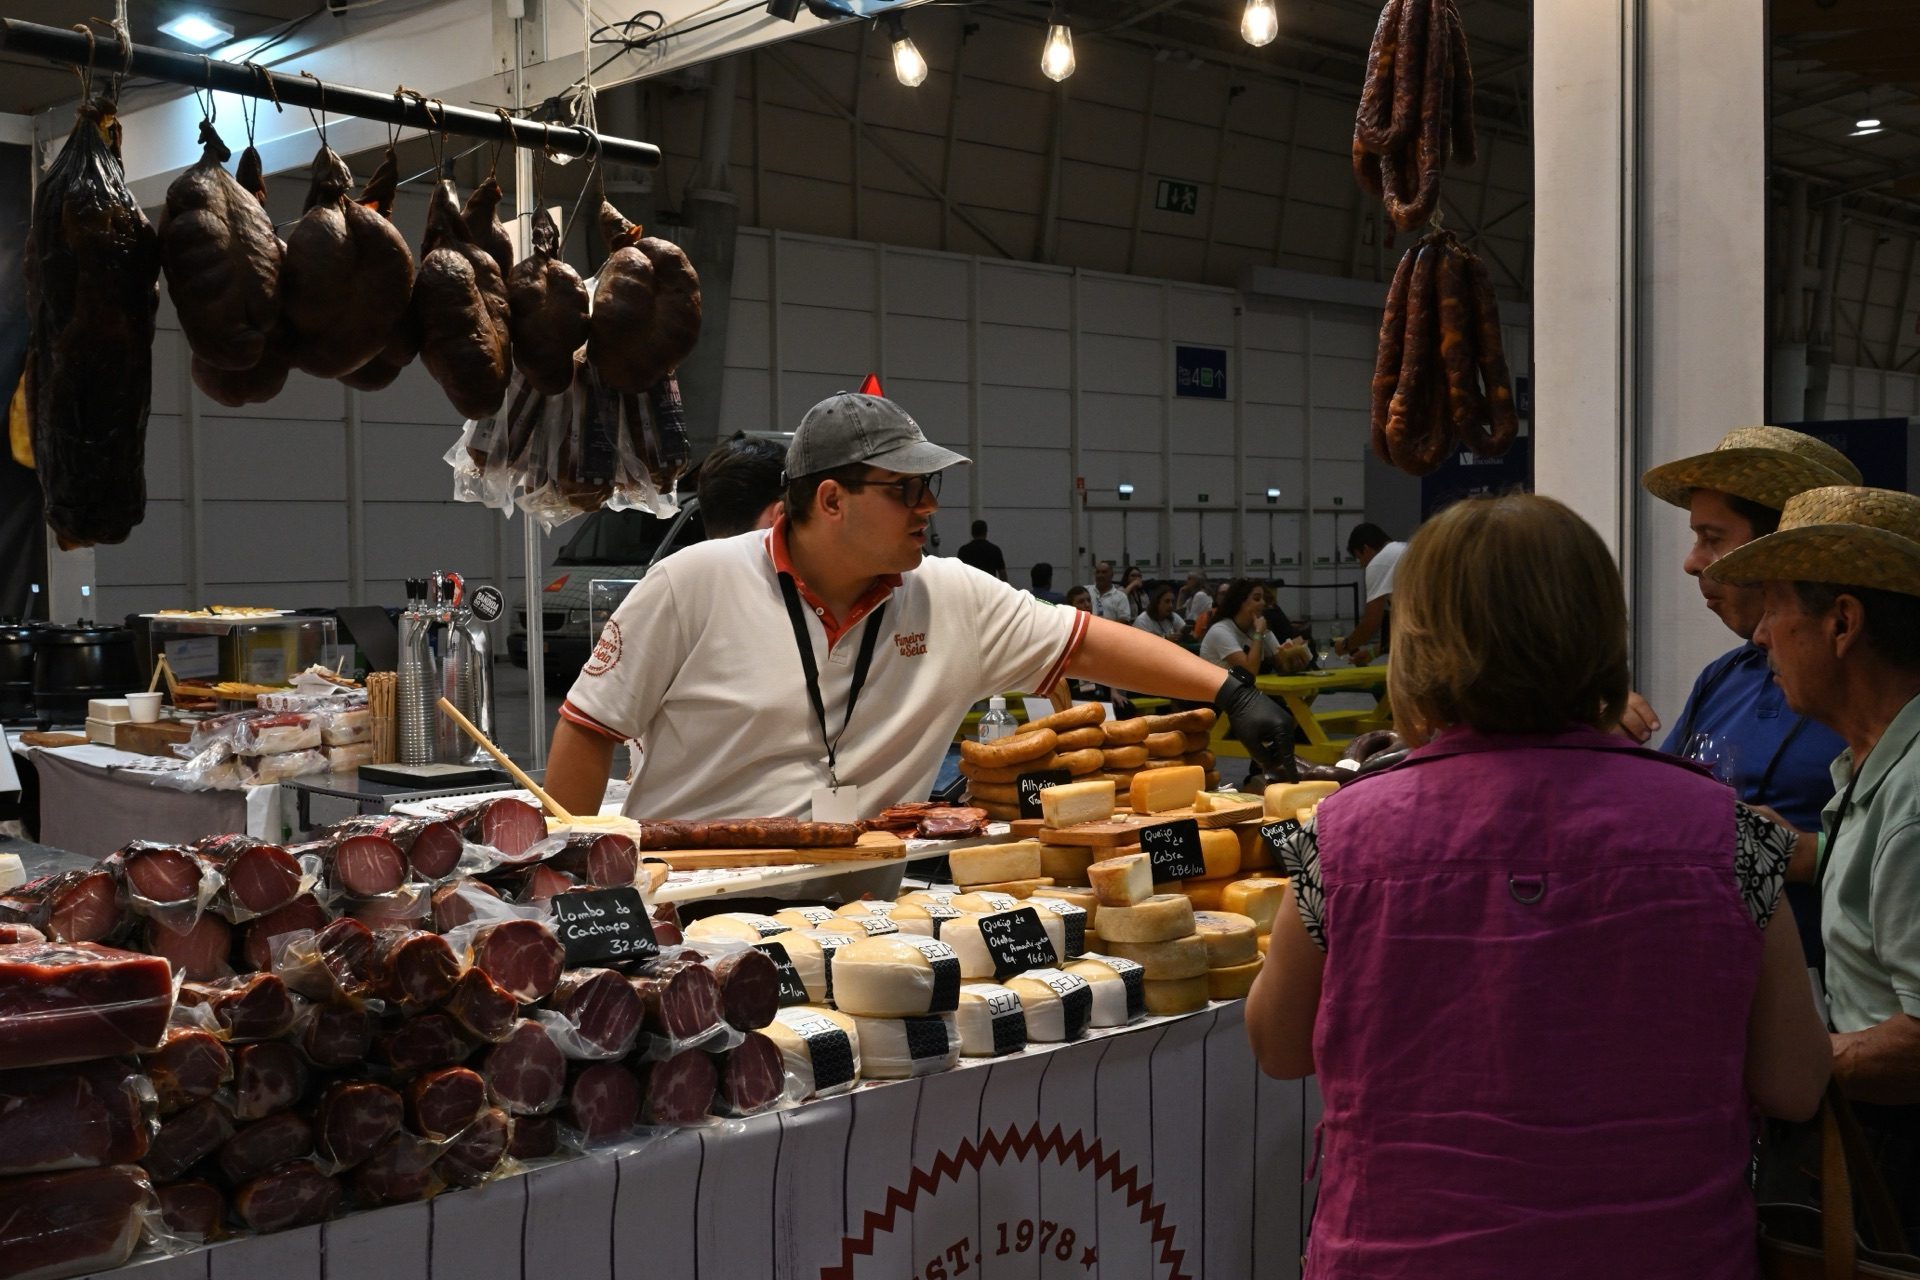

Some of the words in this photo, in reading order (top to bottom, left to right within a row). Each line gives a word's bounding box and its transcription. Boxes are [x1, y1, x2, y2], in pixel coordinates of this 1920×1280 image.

[1192, 367, 1200, 387] 4
[476, 592, 499, 612] BANDIDA
[906, 644, 928, 657] Seia
[1286, 822, 1295, 831] de
[1145, 828, 1172, 843] Queijo
[1173, 836, 1184, 846] de
[1153, 849, 1184, 864] Cabra
[557, 900, 605, 922] Lombo
[615, 899, 630, 915] do
[567, 921, 630, 939] Cachaço
[861, 918, 899, 931] SEIA
[918, 942, 956, 959] SEIA
[1049, 974, 1088, 994] SEIA
[988, 992, 1023, 1016] SEIA
[793, 1019, 839, 1036] SEIA
[912, 1236, 981, 1280] ST.
[996, 1219, 1076, 1261] 1978
